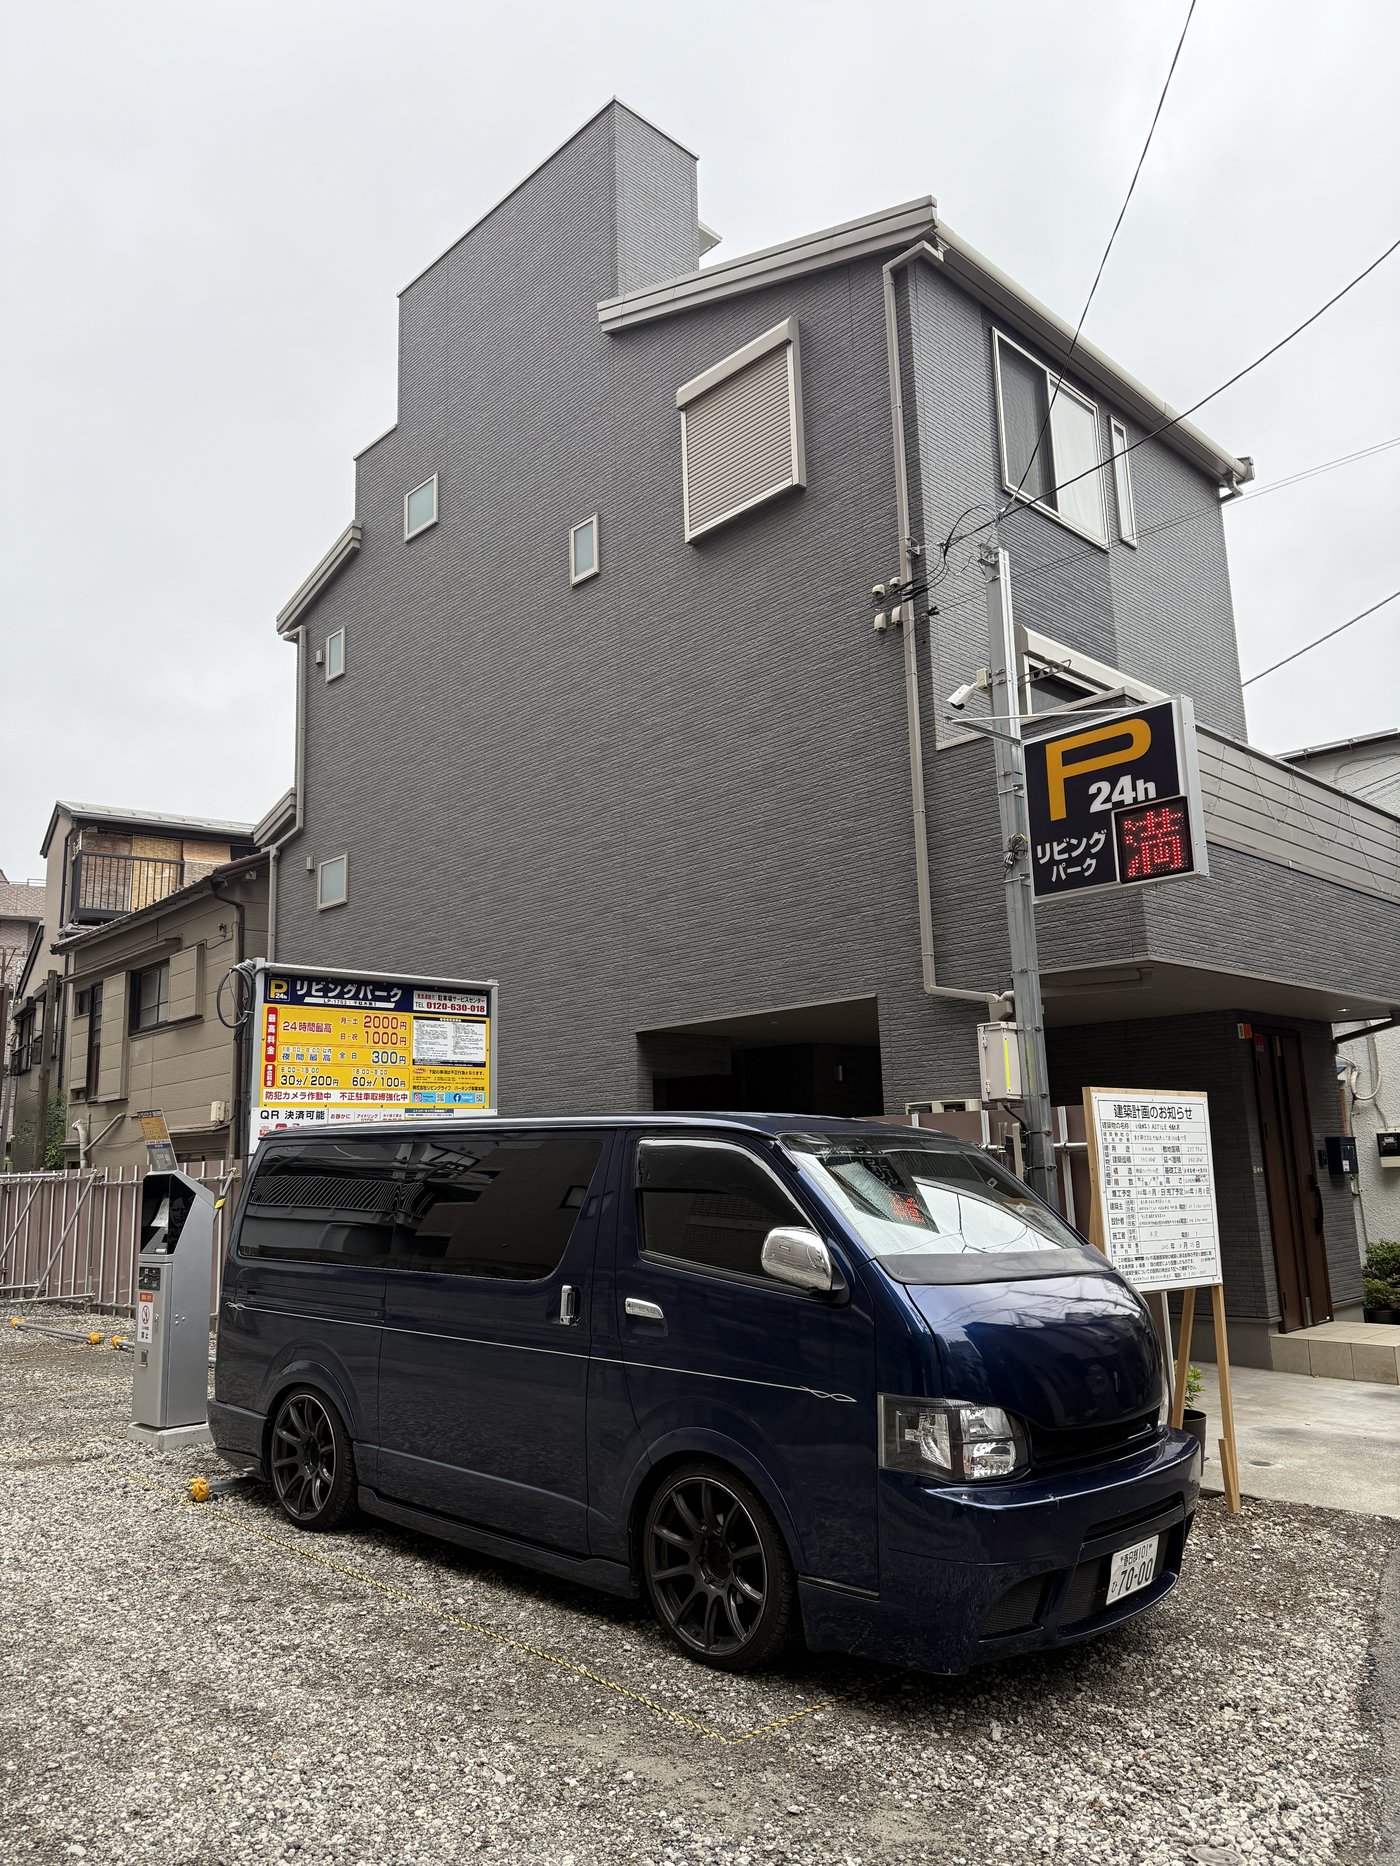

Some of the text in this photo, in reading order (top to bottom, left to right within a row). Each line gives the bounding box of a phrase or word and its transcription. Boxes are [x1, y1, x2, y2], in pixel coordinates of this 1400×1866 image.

[1045, 718, 1152, 822] P
[1088, 774, 1157, 814] 24h
[1036, 828, 1107, 865] リビング
[1123, 807, 1184, 878] 満
[1051, 857, 1097, 882] パーク
[269, 979, 288, 999] P
[296, 980, 403, 1002] リビングパーク
[415, 1001, 485, 1013] TEL 0120-630-018
[282, 1021, 332, 1034] 24時間最高
[363, 1014, 407, 1031] 2000円
[267, 1013, 277, 1055] 最高料金
[364, 1030, 407, 1046] 1000円
[371, 1050, 407, 1065] 300円
[265, 1091, 408, 1102] 防犯カメラ作動中 不正駐車取締強化中
[260, 1110, 326, 1121] QR 決済可能
[1113, 1104, 1192, 1120] 建築計画のお知らせ
[1117, 1557, 1154, 1596] 70-00
